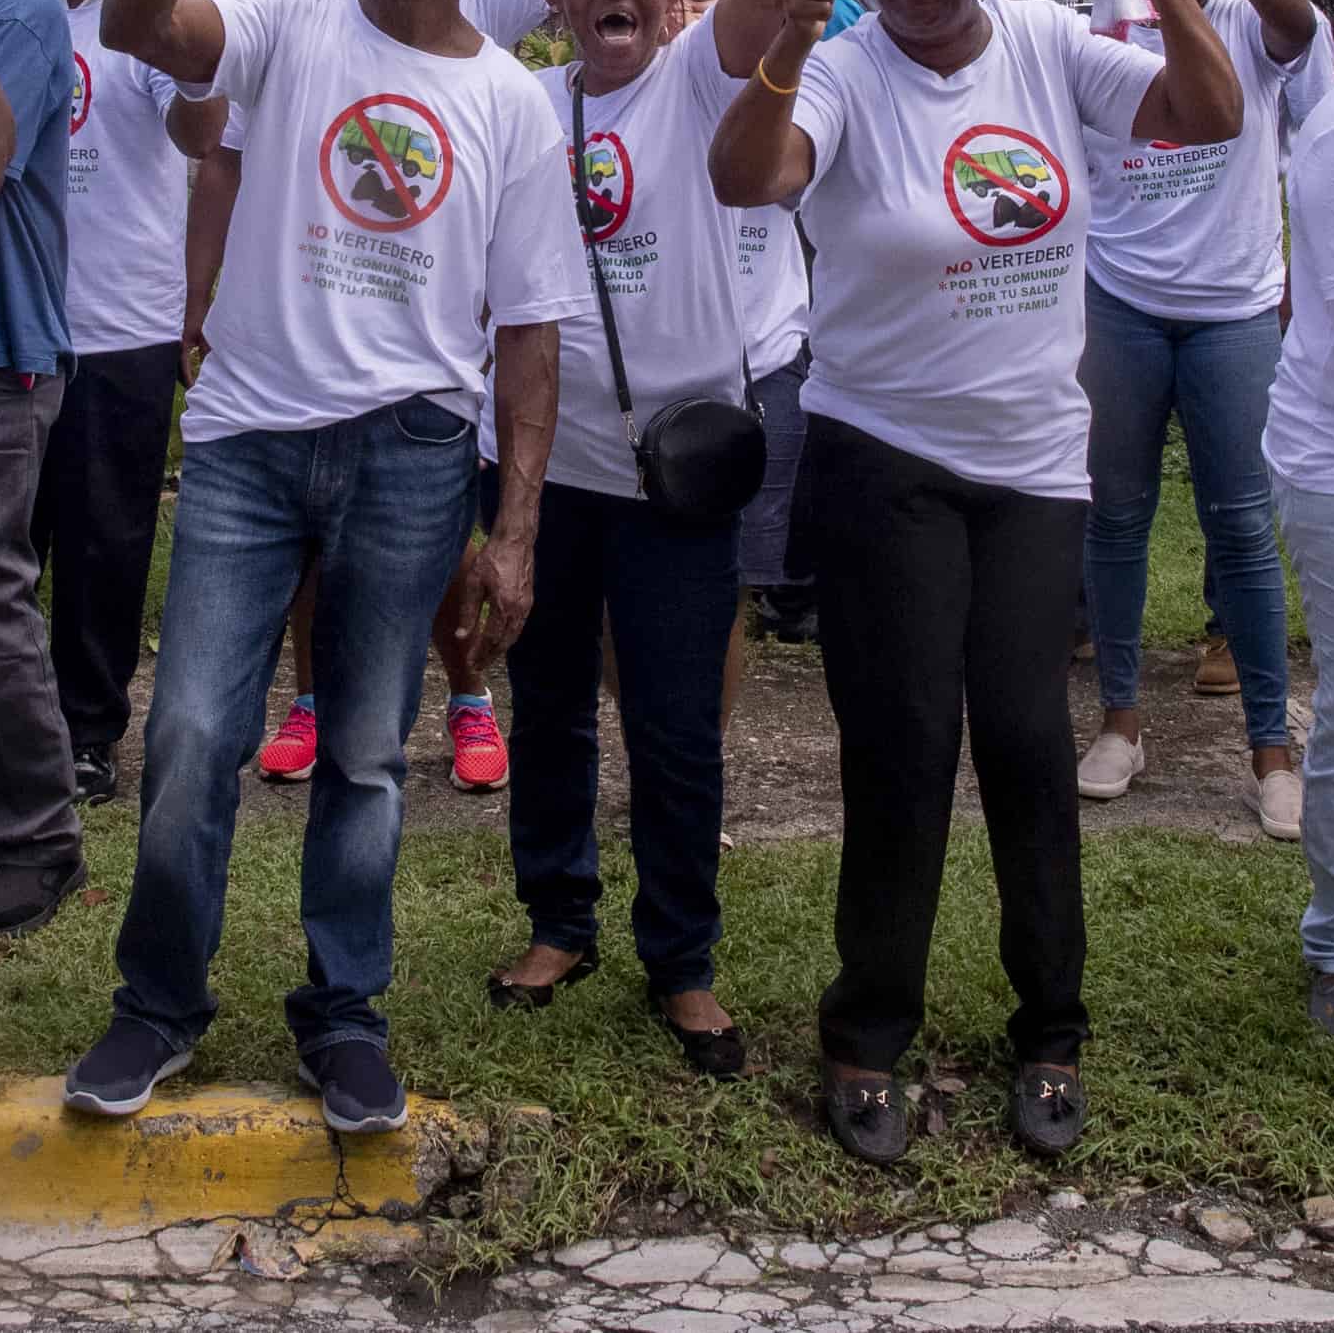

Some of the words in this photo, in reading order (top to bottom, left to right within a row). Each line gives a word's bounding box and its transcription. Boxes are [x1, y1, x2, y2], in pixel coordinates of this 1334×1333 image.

[1123, 158, 1144, 170] NO
[1147, 145, 1227, 167] VERTEDERO
[1152, 171, 1165, 179] TU
[1143, 182, 1163, 191] POR
[1167, 179, 1179, 188] TU
[1183, 173, 1215, 186] SALUD
[1140, 193, 1161, 202] POR
[1164, 190, 1177, 199] TU
[334, 229, 434, 269] VERTEDERO
[333, 251, 347, 263] TU
[945, 260, 973, 275] NO
[979, 244, 1074, 270] VERTEDERO
[347, 270, 363, 283] TU
[339, 283, 356, 295] TU
[950, 279, 977, 290] POR
[981, 277, 1000, 287] TU
[970, 292, 996, 303] POR
[1000, 289, 1017, 300] TU
[1020, 282, 1058, 297] SALUD
[966, 307, 993, 319] POR
[997, 305, 1014, 315] TU
